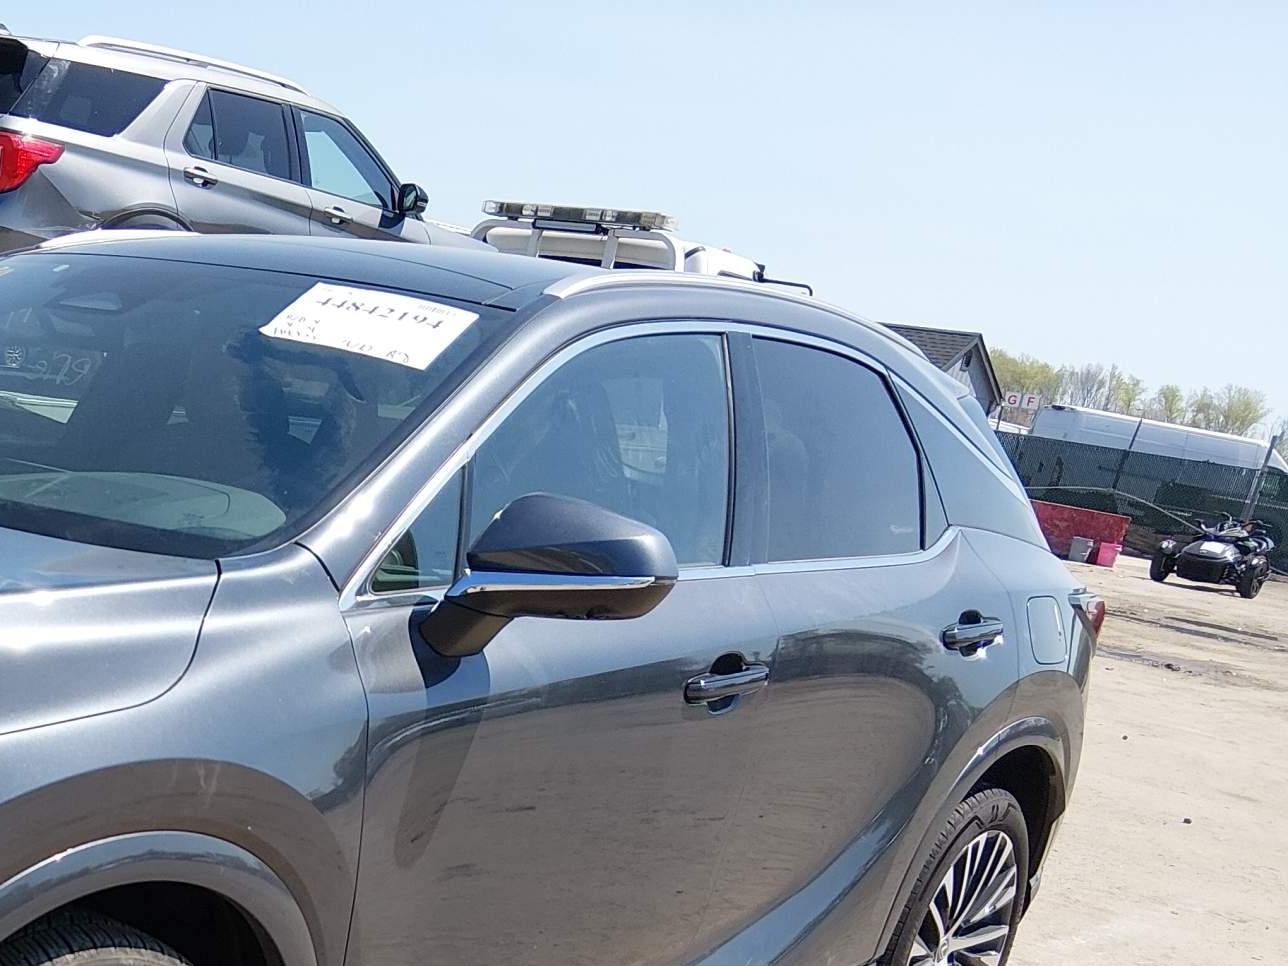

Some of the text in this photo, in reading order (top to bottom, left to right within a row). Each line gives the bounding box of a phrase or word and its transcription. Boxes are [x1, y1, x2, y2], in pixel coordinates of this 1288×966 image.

[315, 297, 444, 330] 44842194
[1007, 394, 1018, 406] G
[1026, 396, 1036, 407] F
